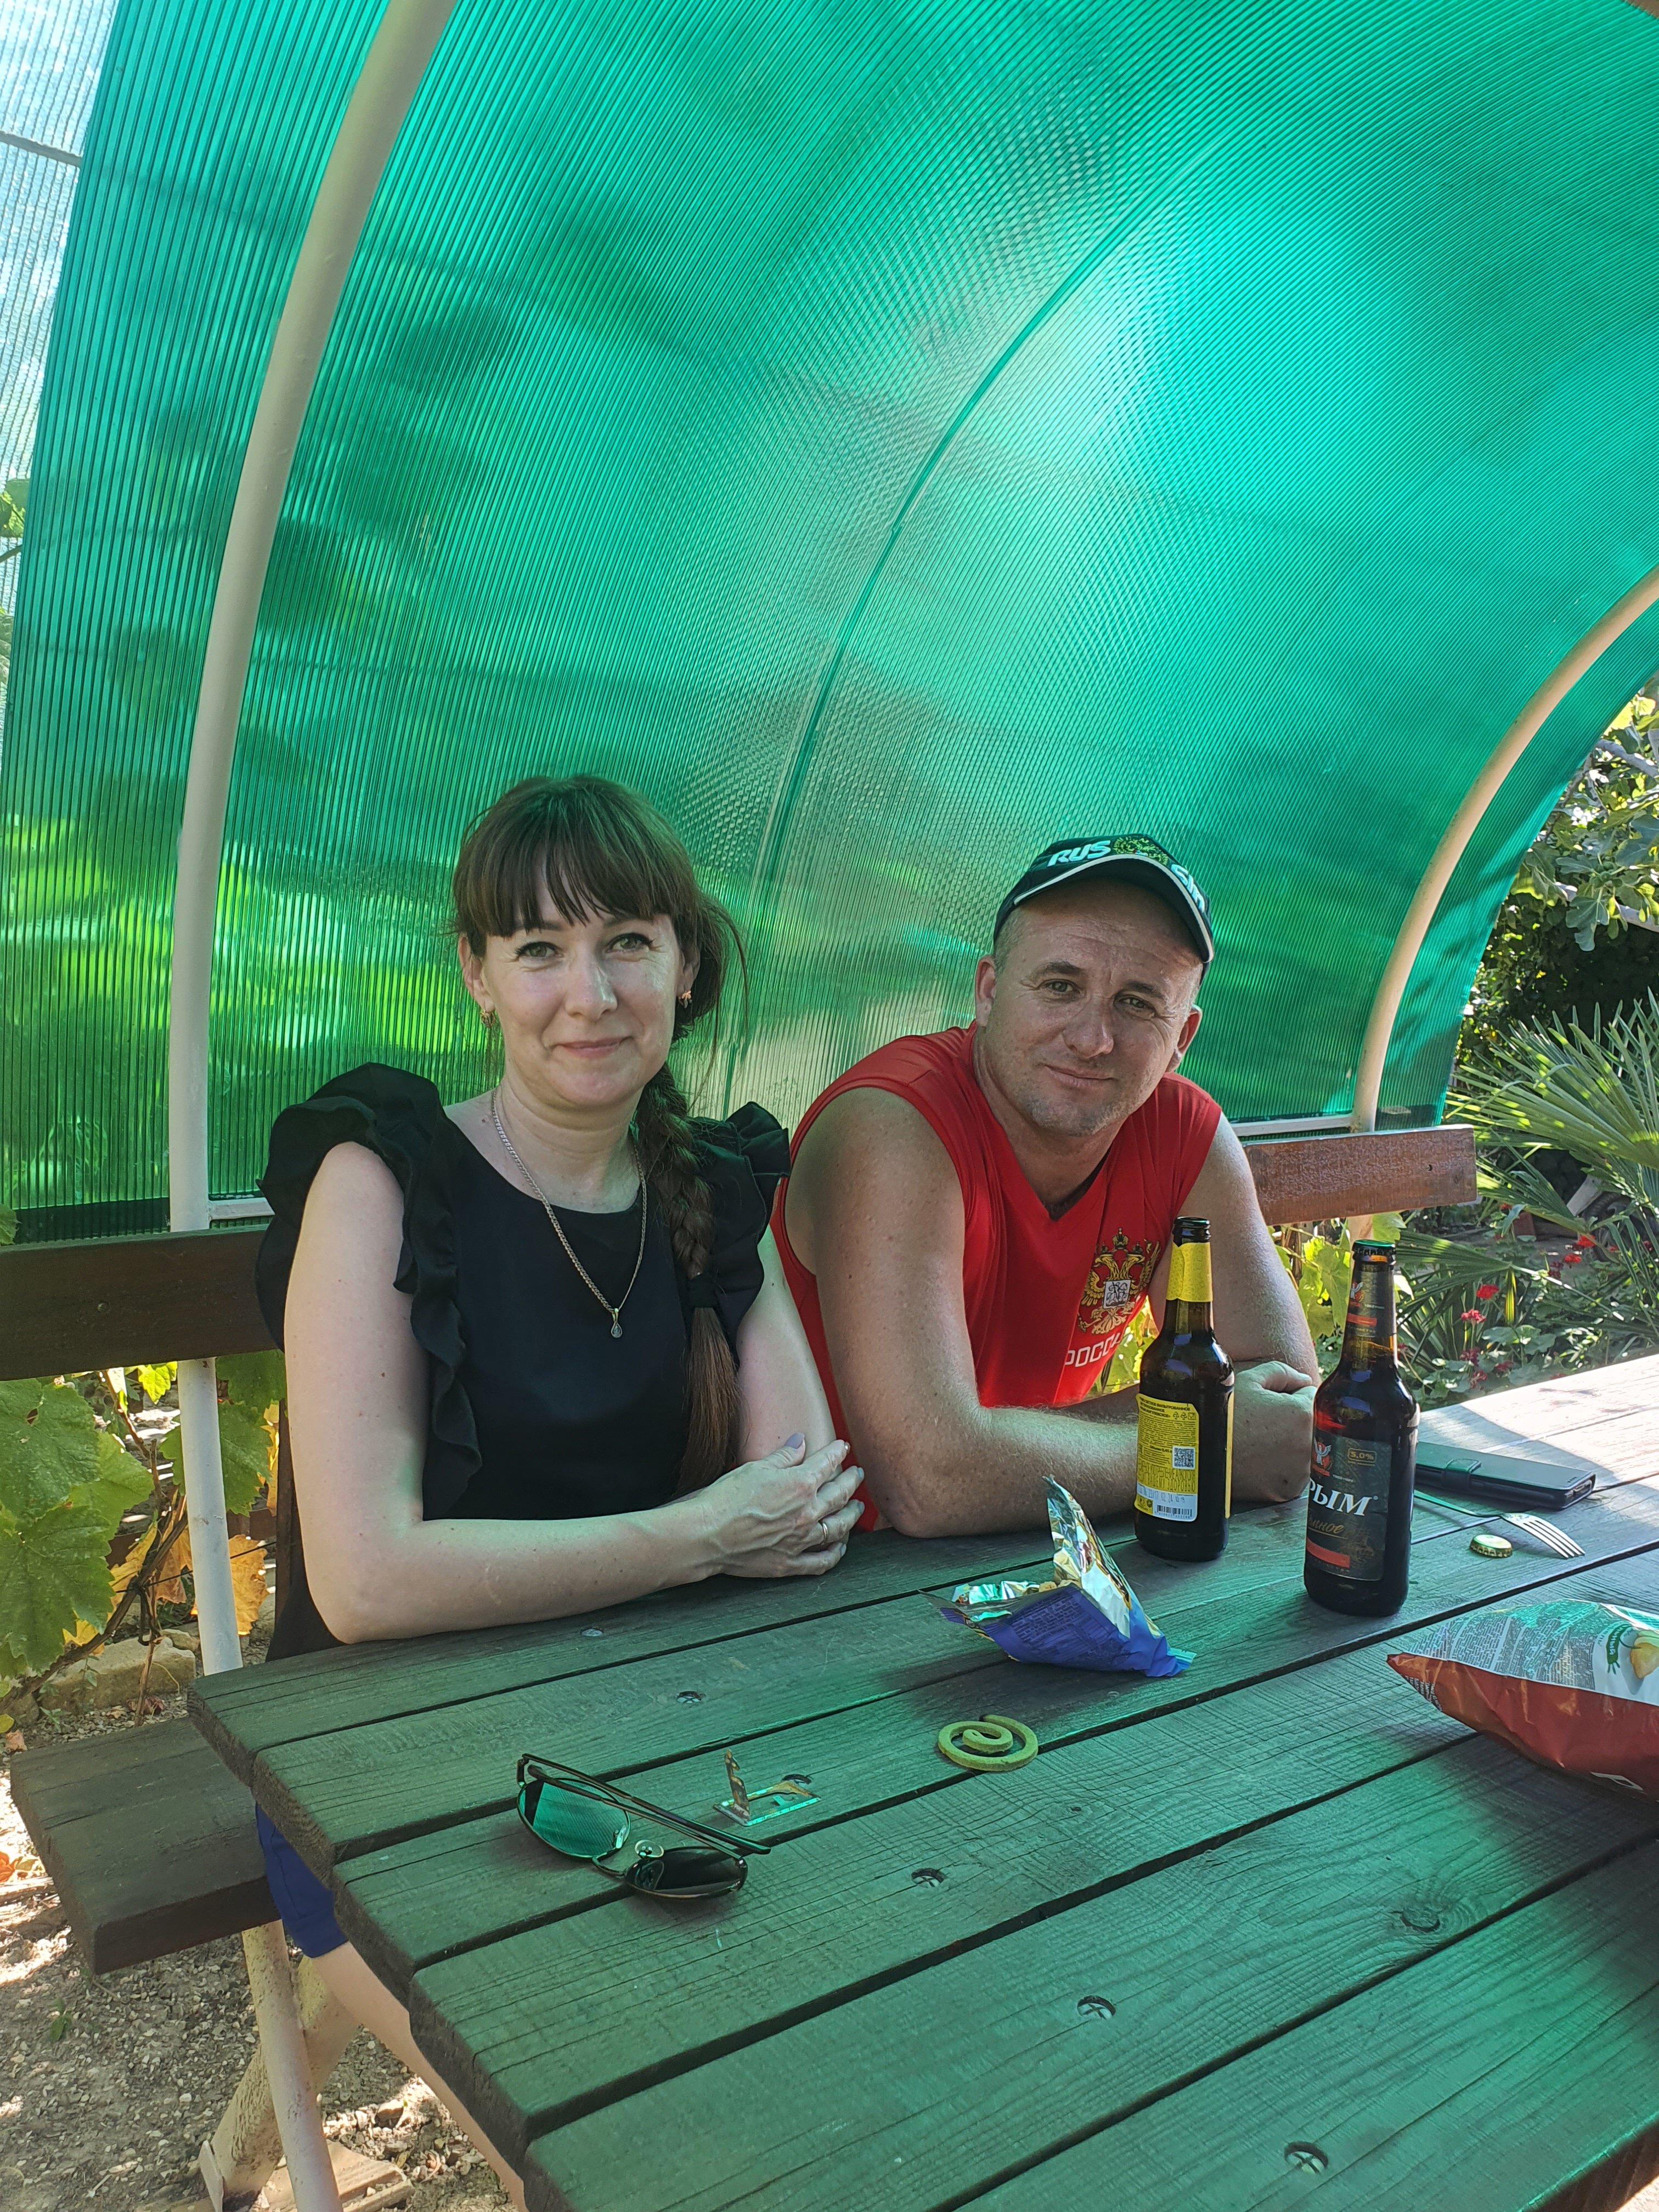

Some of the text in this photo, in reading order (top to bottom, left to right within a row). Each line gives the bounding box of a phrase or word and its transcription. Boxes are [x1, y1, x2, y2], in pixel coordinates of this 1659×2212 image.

[1047, 840, 1205, 913] RUS SIA
[1064, 1332, 1121, 1368] РОССИ
[1350, 1451, 1374, 1460] 5.0%
[1309, 1476, 1373, 1516] РЫМ
